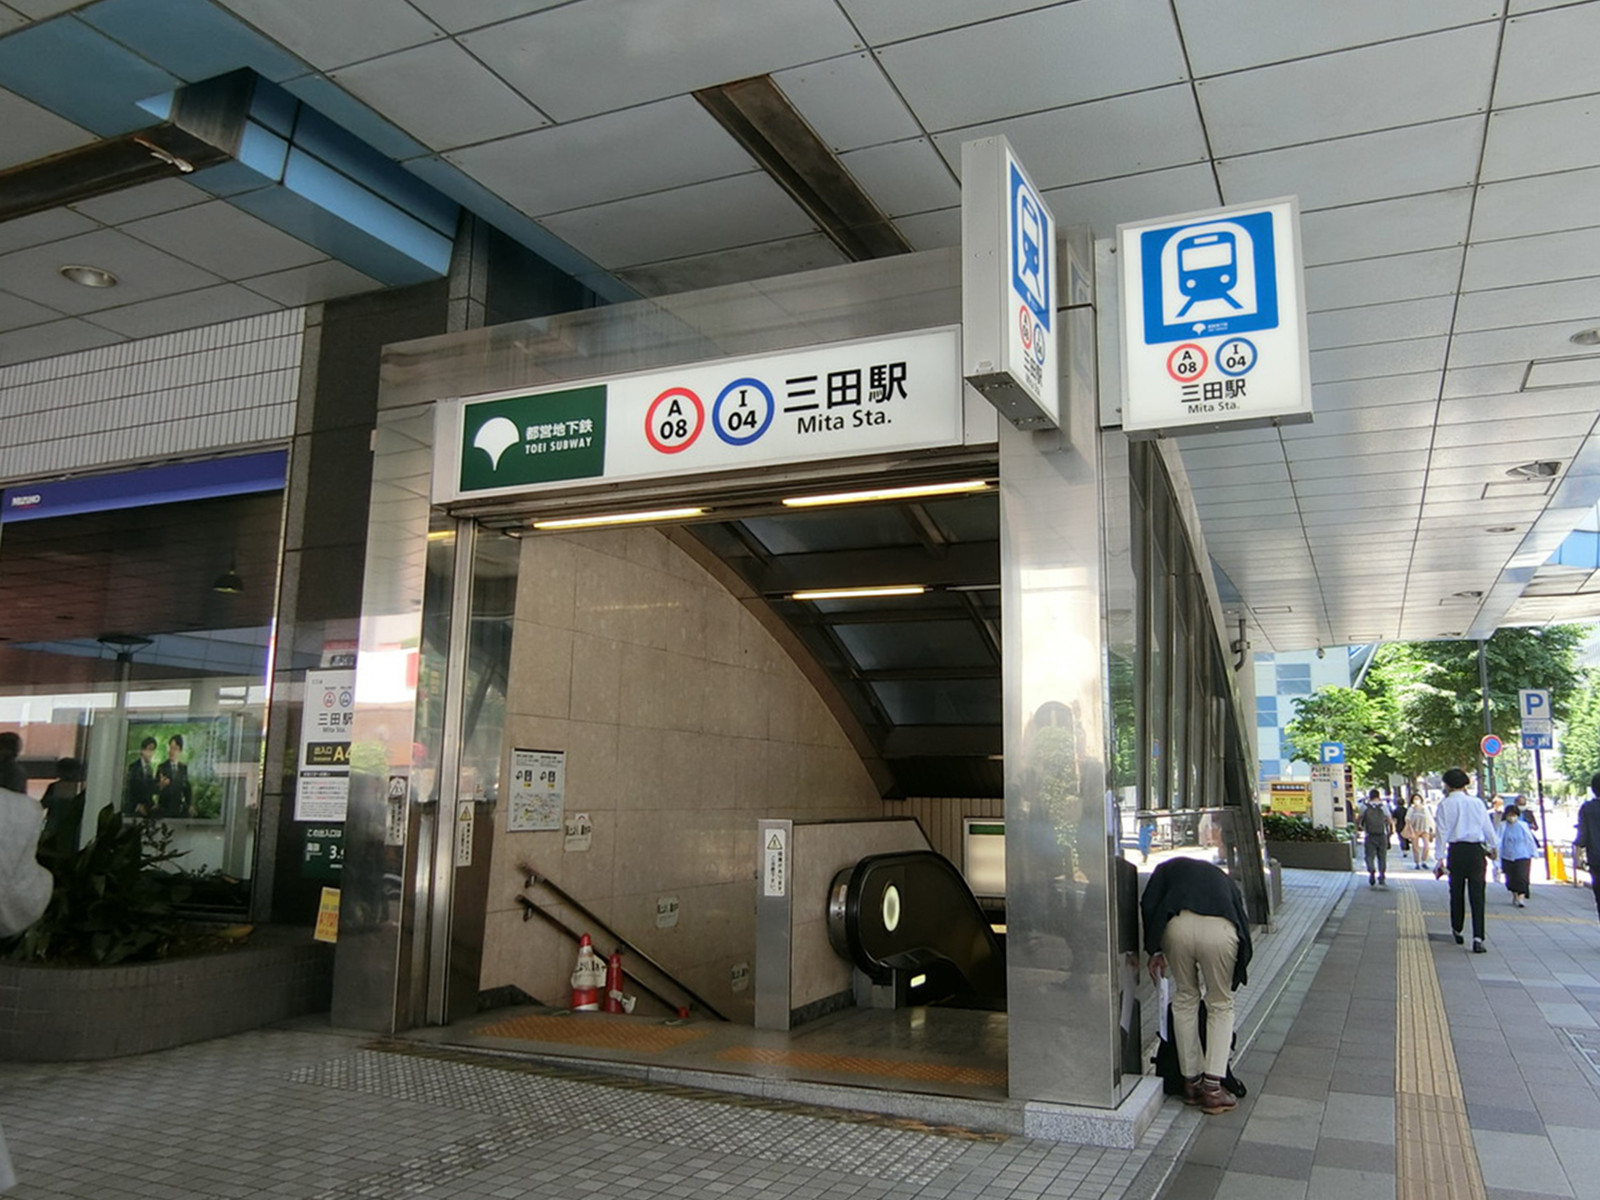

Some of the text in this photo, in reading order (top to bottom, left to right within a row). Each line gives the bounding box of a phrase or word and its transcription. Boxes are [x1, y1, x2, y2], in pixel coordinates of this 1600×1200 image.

[1182, 350, 1192, 361] A
[1232, 344, 1239, 355] I
[1177, 361, 1197, 375] 08
[1226, 356, 1246, 369] 04
[783, 361, 908, 413] 三田駅
[1181, 378, 1246, 403] 三田駅
[738, 389, 748, 408] I
[1188, 400, 1240, 414] Mita Sta.
[667, 399, 683, 418] A
[525, 418, 593, 440] 都営地下鉄
[659, 418, 688, 440] 08
[727, 410, 758, 432] 04
[797, 409, 892, 435] Mita Sta.
[525, 436, 593, 454] TOEI SUBWAY
[1525, 693, 1544, 715] P
[318, 712, 353, 725] 三田駅
[1323, 745, 1340, 762] P
